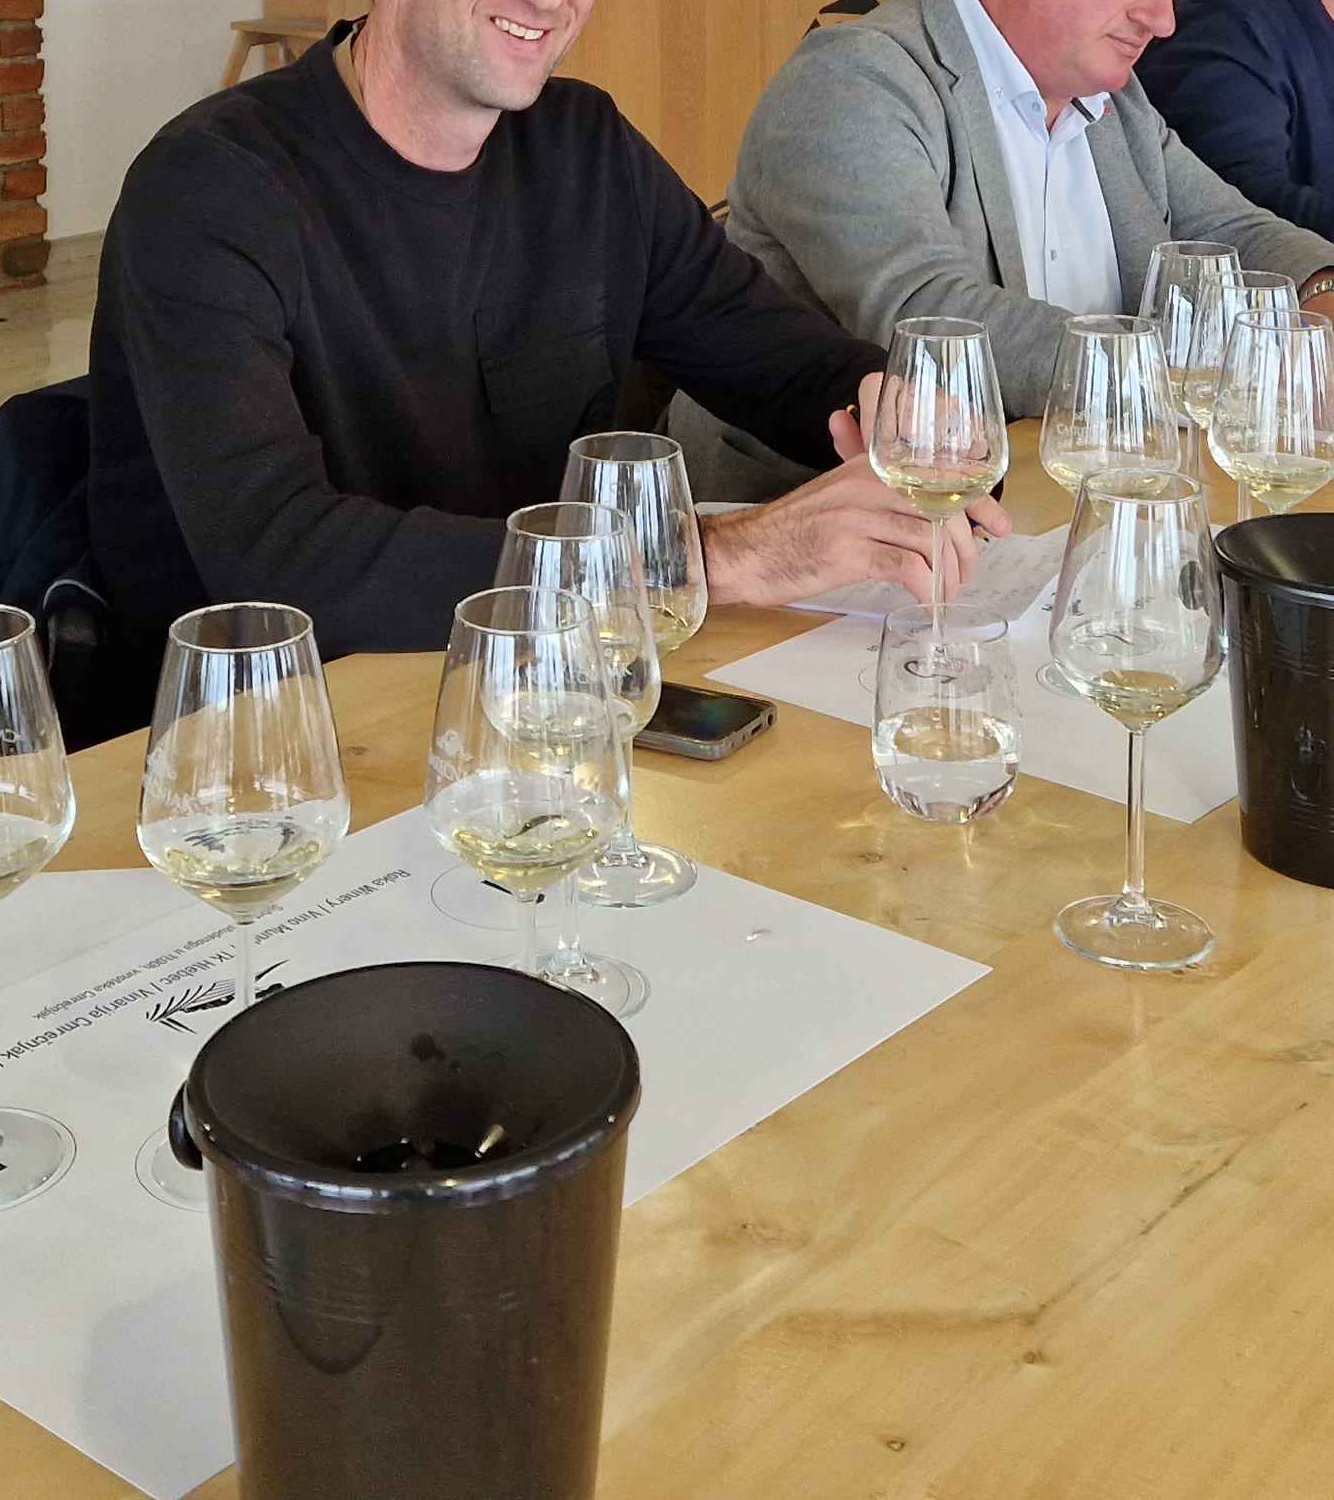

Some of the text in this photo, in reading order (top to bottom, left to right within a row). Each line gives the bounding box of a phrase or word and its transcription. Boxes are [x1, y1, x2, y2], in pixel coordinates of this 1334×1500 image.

[371, 868, 412, 889] Roka
[324, 879, 378, 910] Winery
[287, 908, 323, 928] Vino
[159, 957, 217, 986] Hlebec
[87, 986, 155, 1020] Vinarija
[0, 1015, 93, 1060] Cmrečnjak
